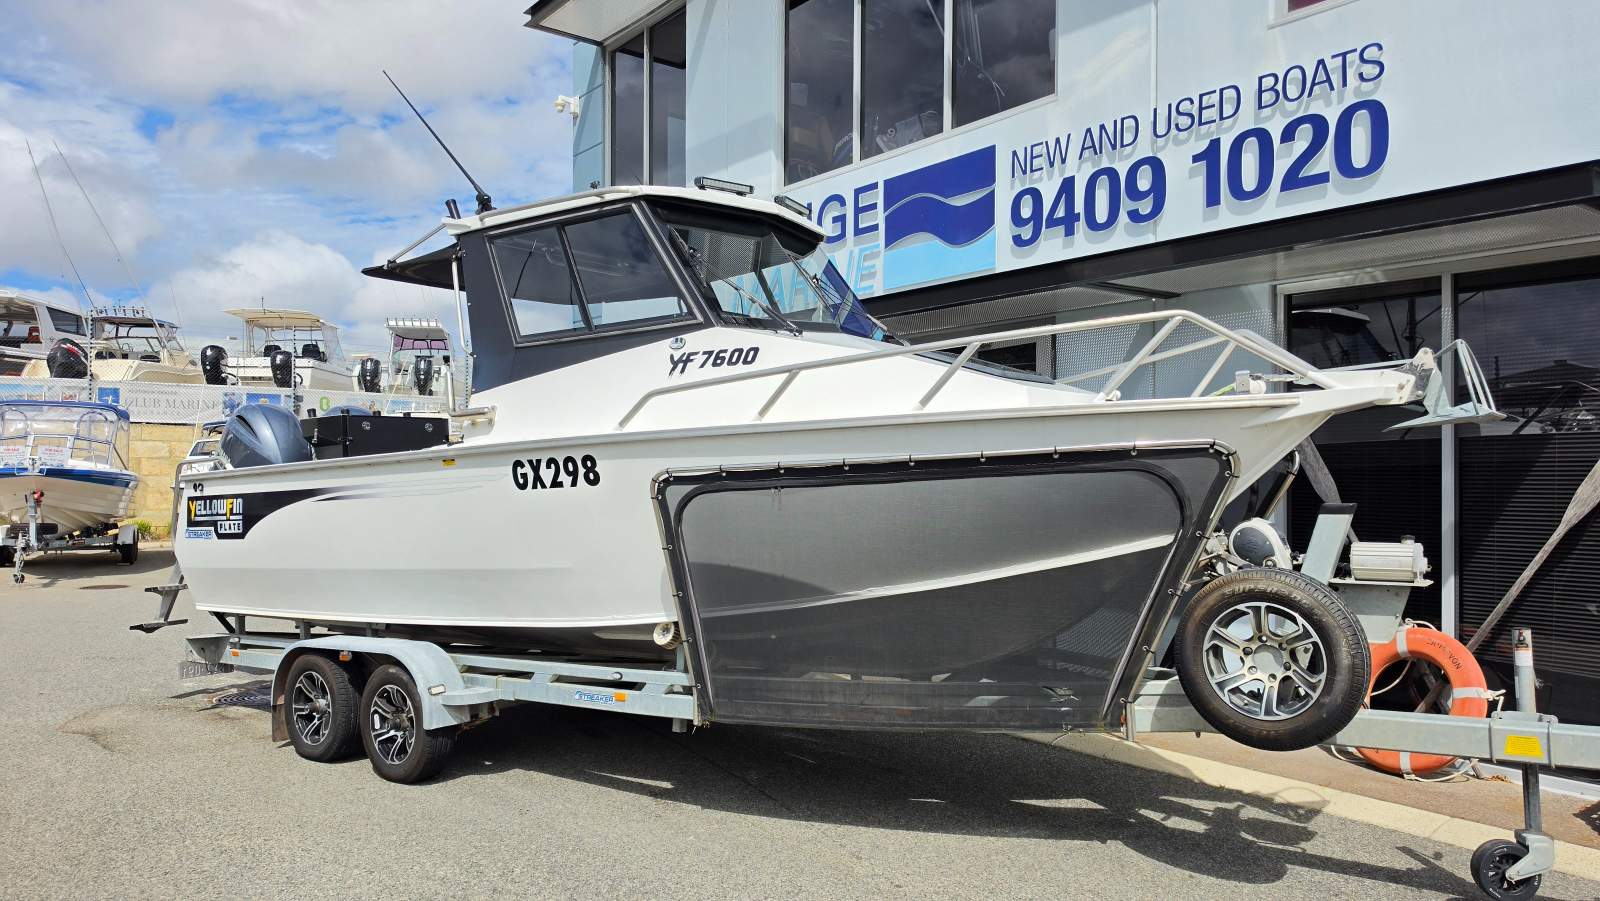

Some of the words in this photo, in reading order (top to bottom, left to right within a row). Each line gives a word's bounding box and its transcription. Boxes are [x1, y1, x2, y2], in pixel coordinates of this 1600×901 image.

[1010, 132, 1072, 178] NEW
[1079, 114, 1140, 159] AND
[1153, 84, 1242, 139] USED
[1257, 42, 1386, 110] BOATS
[1010, 156, 1167, 249] 9409
[1191, 98, 1390, 210] 1020
[806, 181, 880, 245] GE
[698, 346, 760, 369] 7600
[512, 454, 601, 491] GX298
[219, 522, 241, 532] PLATE
